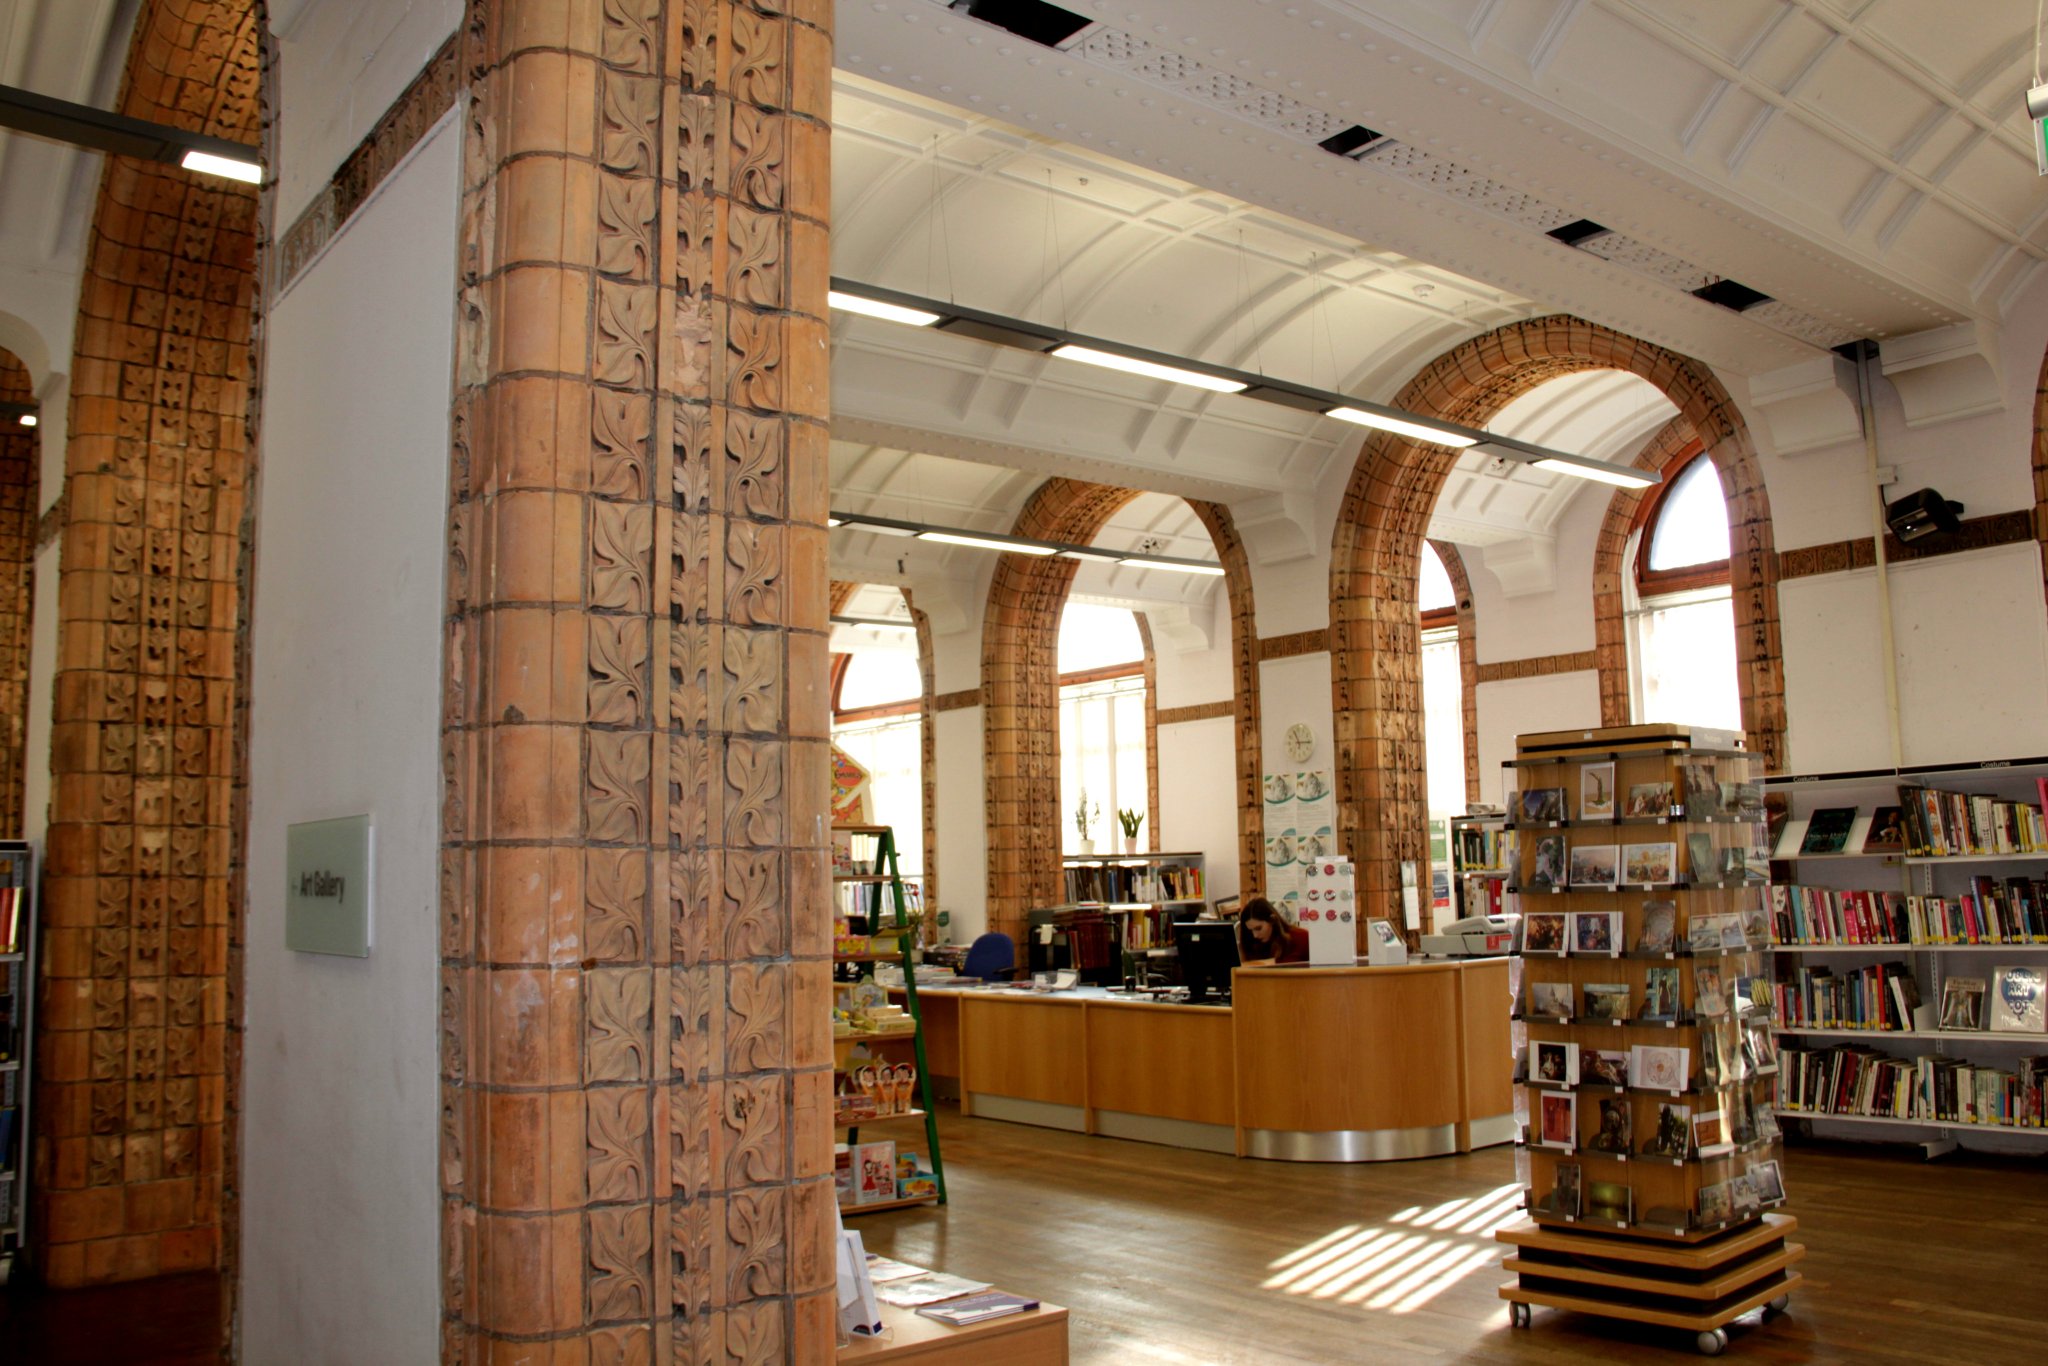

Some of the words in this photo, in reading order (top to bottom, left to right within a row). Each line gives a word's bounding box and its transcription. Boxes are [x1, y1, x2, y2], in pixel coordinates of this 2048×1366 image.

[1980, 760, 2010, 768] Costume
[1793, 775, 1820, 783] Costume
[299, 870, 313, 897] Art
[314, 869, 346, 904] Gallery
